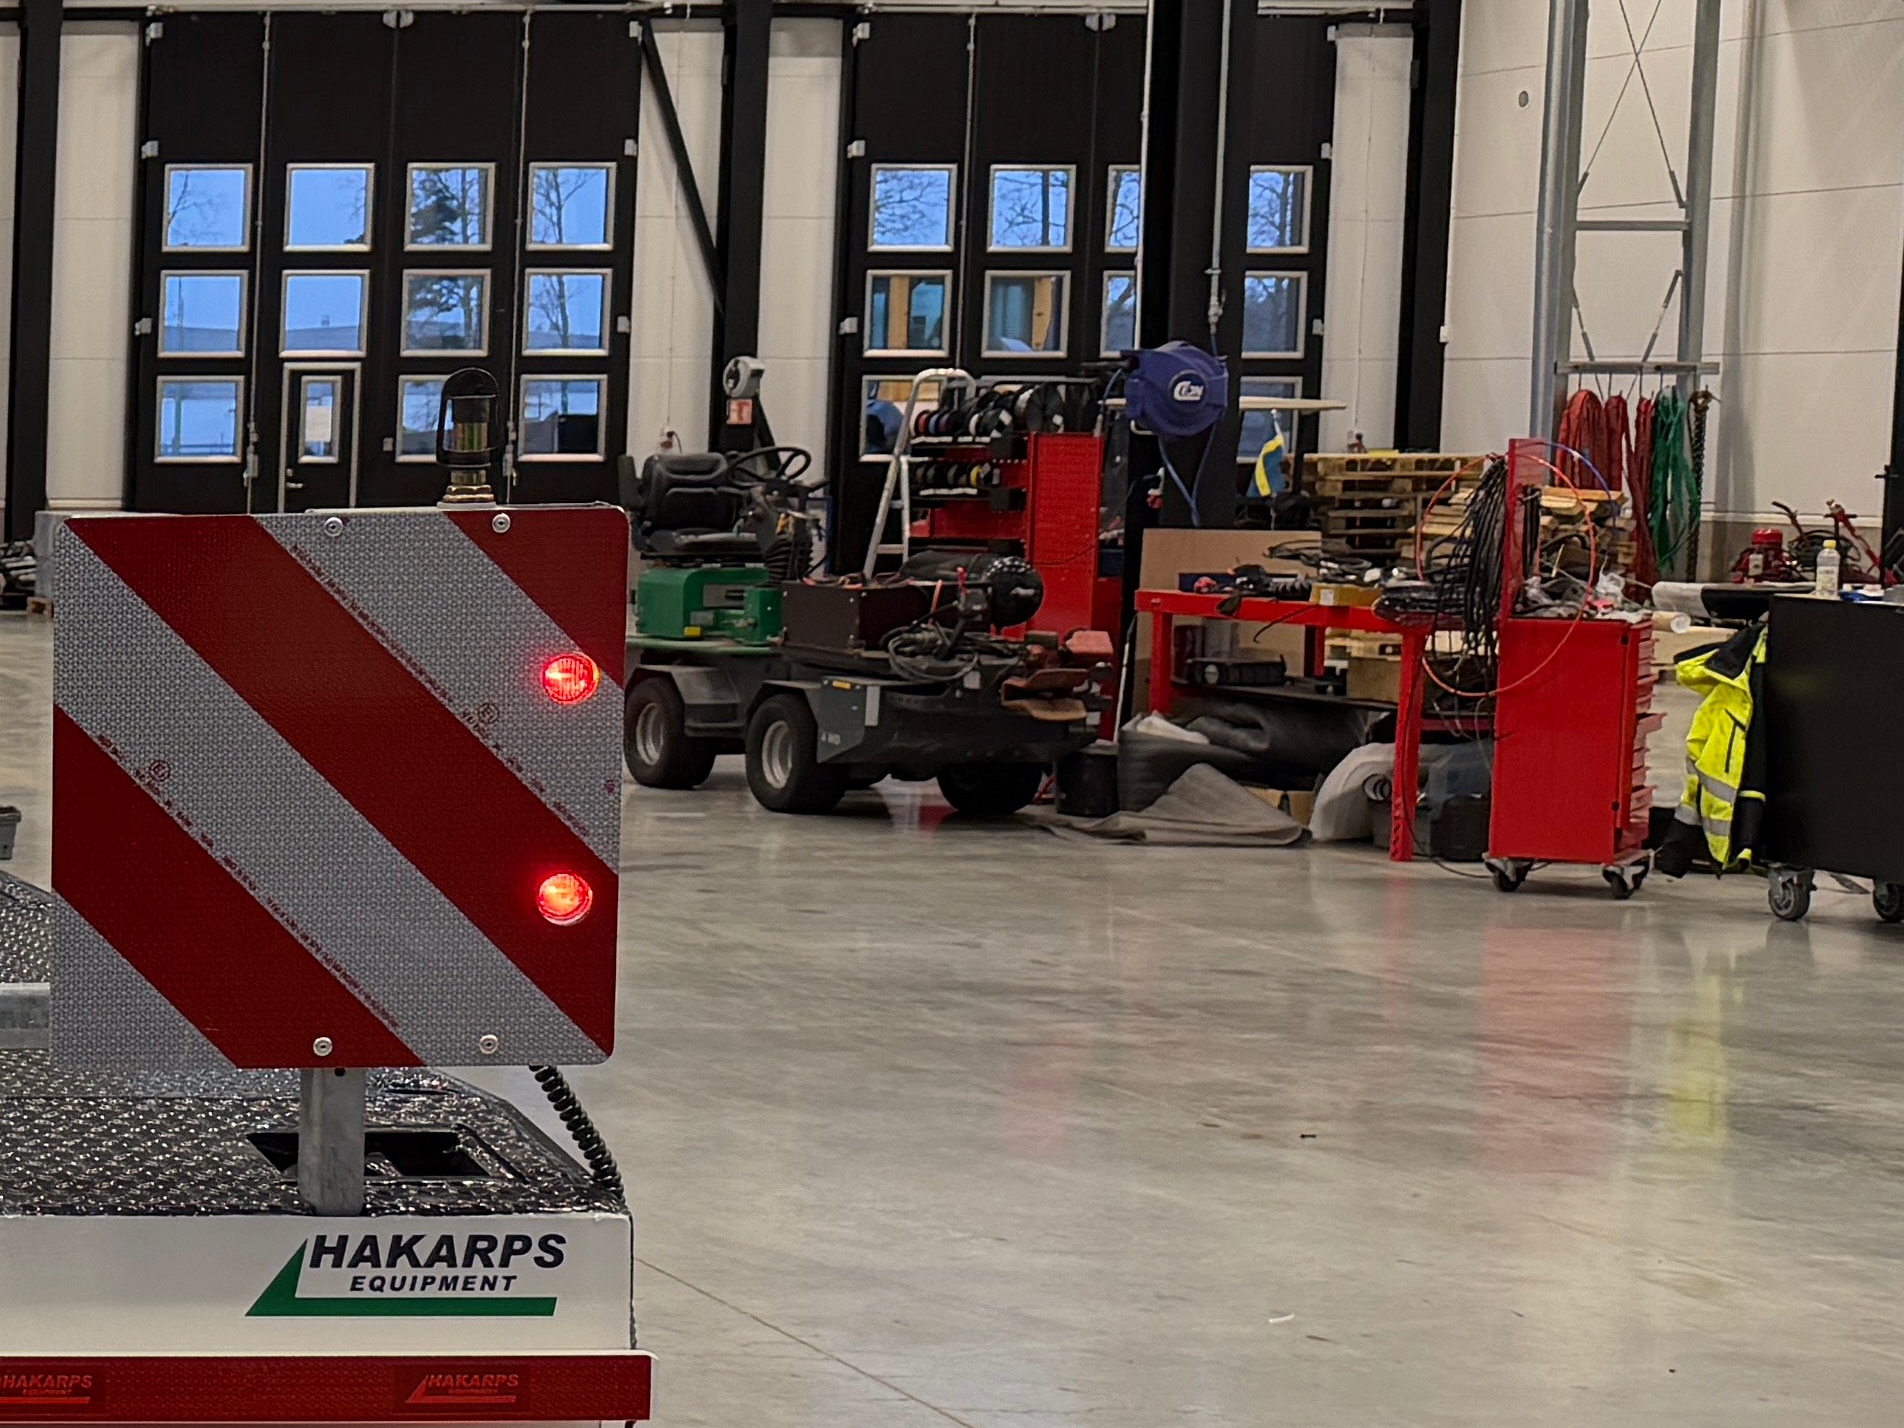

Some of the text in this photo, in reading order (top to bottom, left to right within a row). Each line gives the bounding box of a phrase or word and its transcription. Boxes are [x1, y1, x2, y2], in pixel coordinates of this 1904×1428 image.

[308, 1233, 567, 1269] HAKARPS
[349, 1275, 518, 1293] EQUIPMENT
[3, 1374, 93, 1388] HAKARPS
[428, 1374, 519, 1388] HAKARPS
